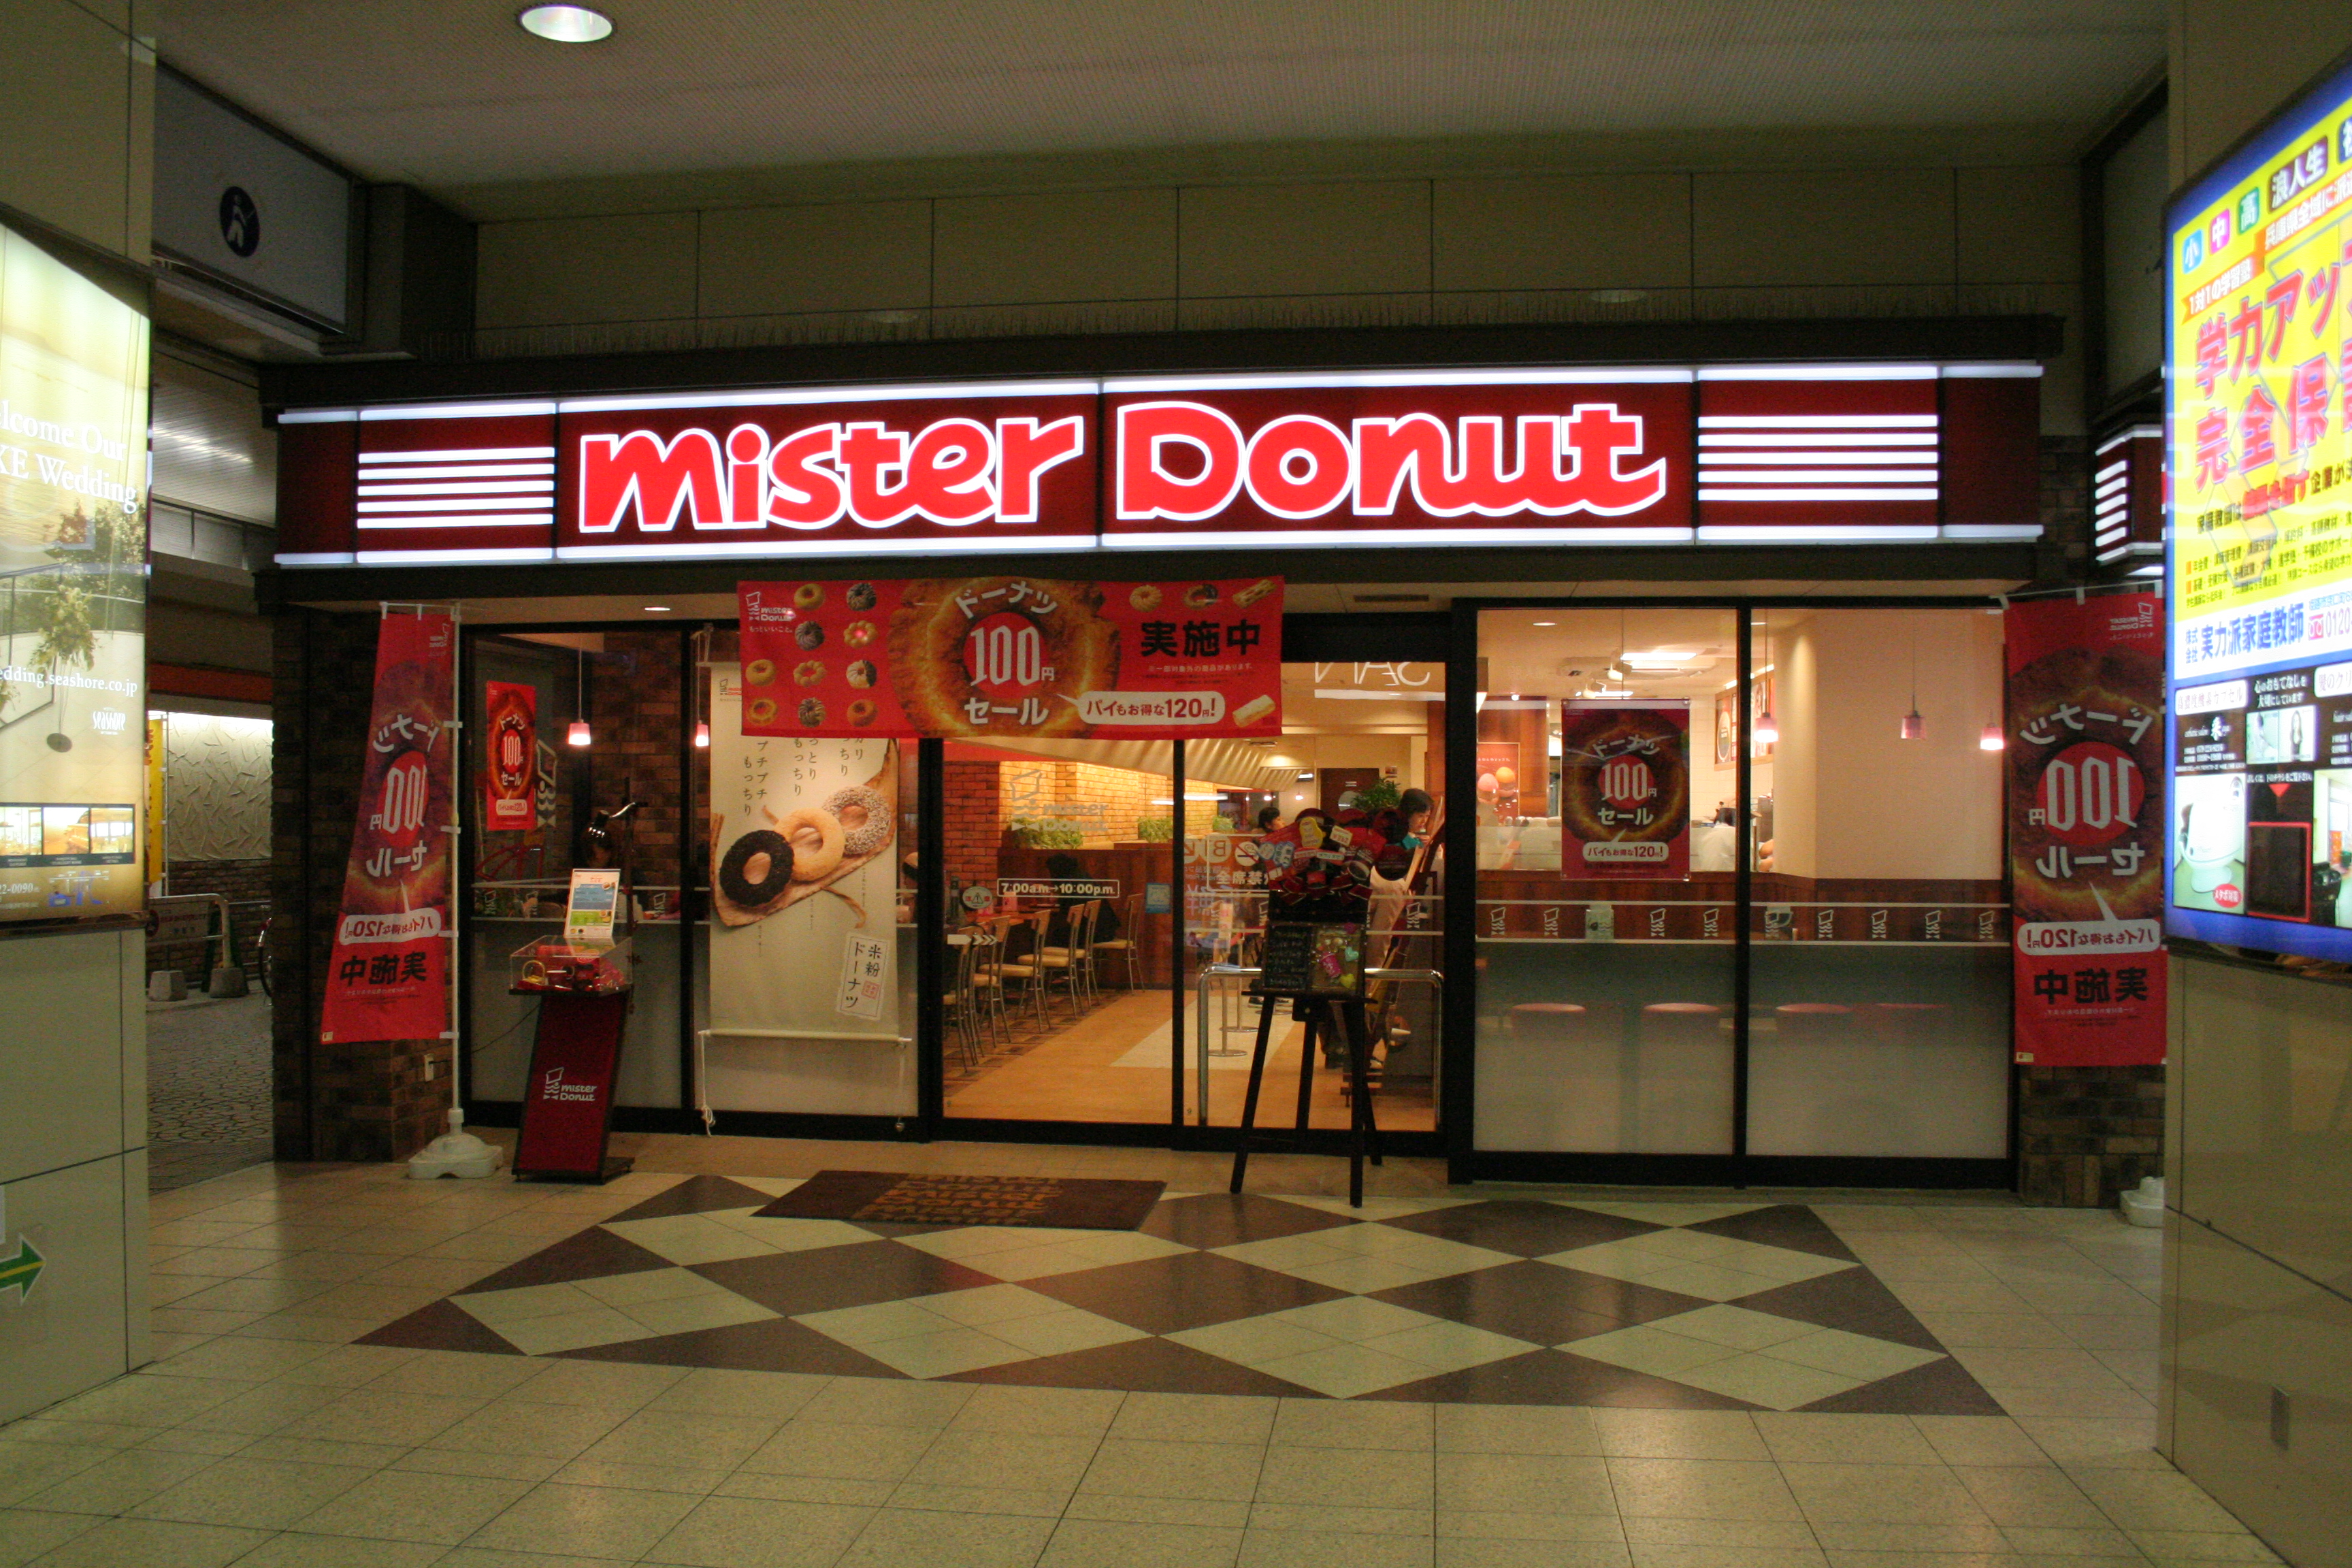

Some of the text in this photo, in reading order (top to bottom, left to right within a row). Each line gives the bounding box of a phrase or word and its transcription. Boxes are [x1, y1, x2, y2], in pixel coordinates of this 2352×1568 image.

[2272, 141, 2325, 209] 浪人生
[2195, 235, 2352, 400] 学力アッ
[0, 399, 127, 461] lcome Our
[2194, 338, 2352, 493] 完全保
[35, 453, 137, 514] Wedding
[1117, 400, 1667, 520] Donut
[955, 581, 1058, 619] ドーナツ
[2325, 606, 2352, 638] 0120
[970, 624, 1055, 687] 100円
[1141, 619, 1260, 657] 実施中
[2201, 602, 2304, 662] 実力派家庭教師
[964, 697, 1049, 725] セール
[1592, 734, 1661, 758] ドーナツ
[742, 756, 753, 816] もっちり
[1601, 762, 1657, 801] 100円
[1597, 807, 1654, 826] セール
[845, 941, 866, 1008] ドーナツ
[864, 943, 882, 978] 米粉
